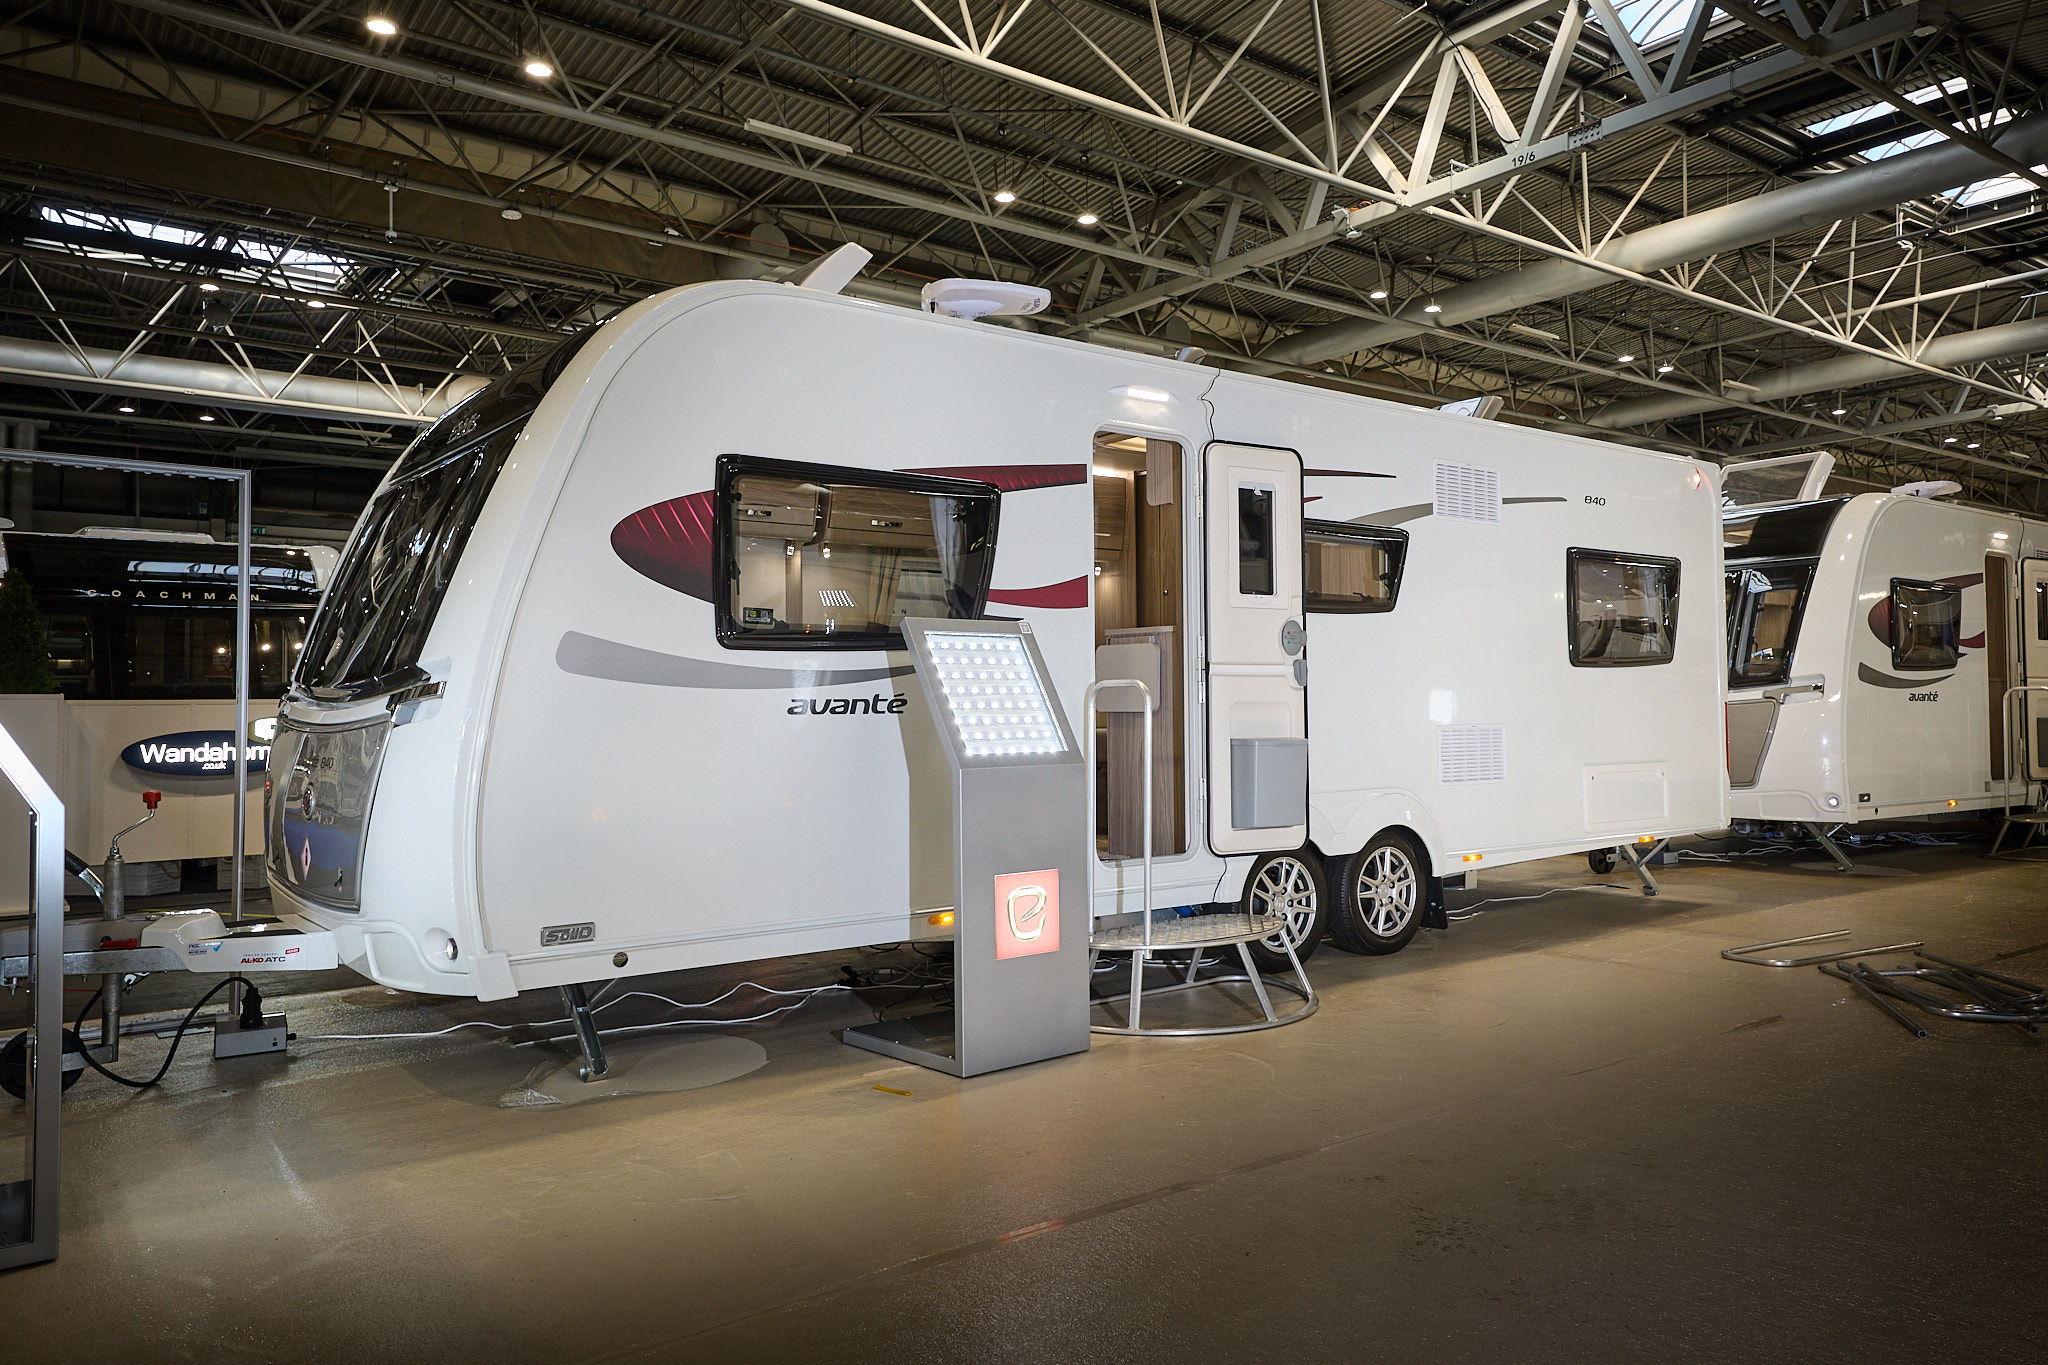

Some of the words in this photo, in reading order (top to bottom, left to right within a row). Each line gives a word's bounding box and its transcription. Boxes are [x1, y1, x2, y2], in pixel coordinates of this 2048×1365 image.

[1511, 151, 1536, 167] 19/6
[1584, 495, 1606, 506] 840
[88, 589, 259, 602] COACHMAN
[1909, 691, 1939, 702] avanté
[787, 693, 908, 715] avanté
